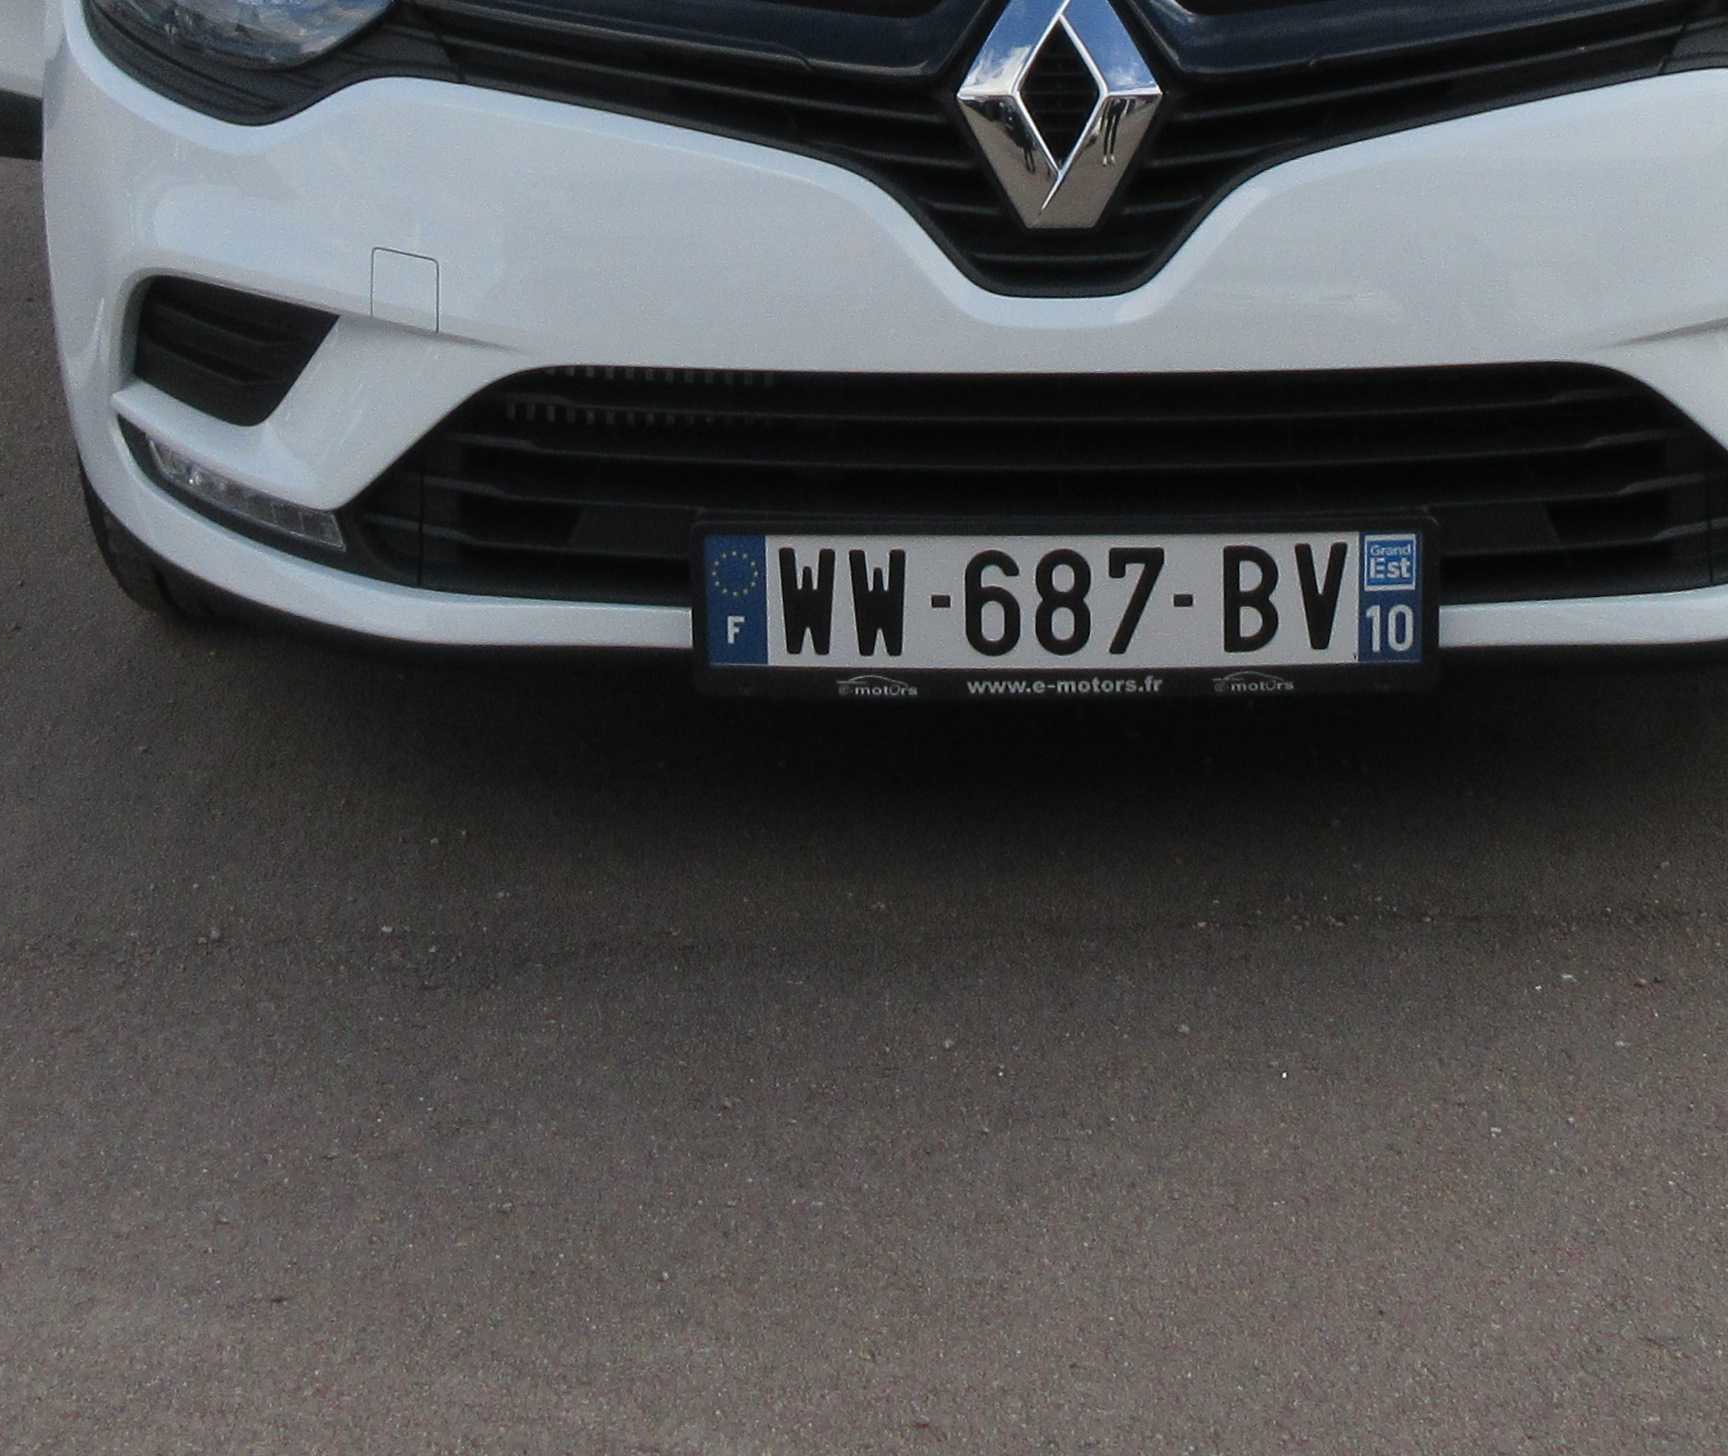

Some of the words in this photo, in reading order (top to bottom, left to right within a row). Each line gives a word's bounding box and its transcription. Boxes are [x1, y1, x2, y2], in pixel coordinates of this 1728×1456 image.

[1369, 544, 1412, 556] Grand
[1369, 556, 1411, 579] Est
[727, 615, 746, 645] F
[1365, 604, 1414, 653] 10
[966, 675, 1163, 694] www.e-motors.fr
